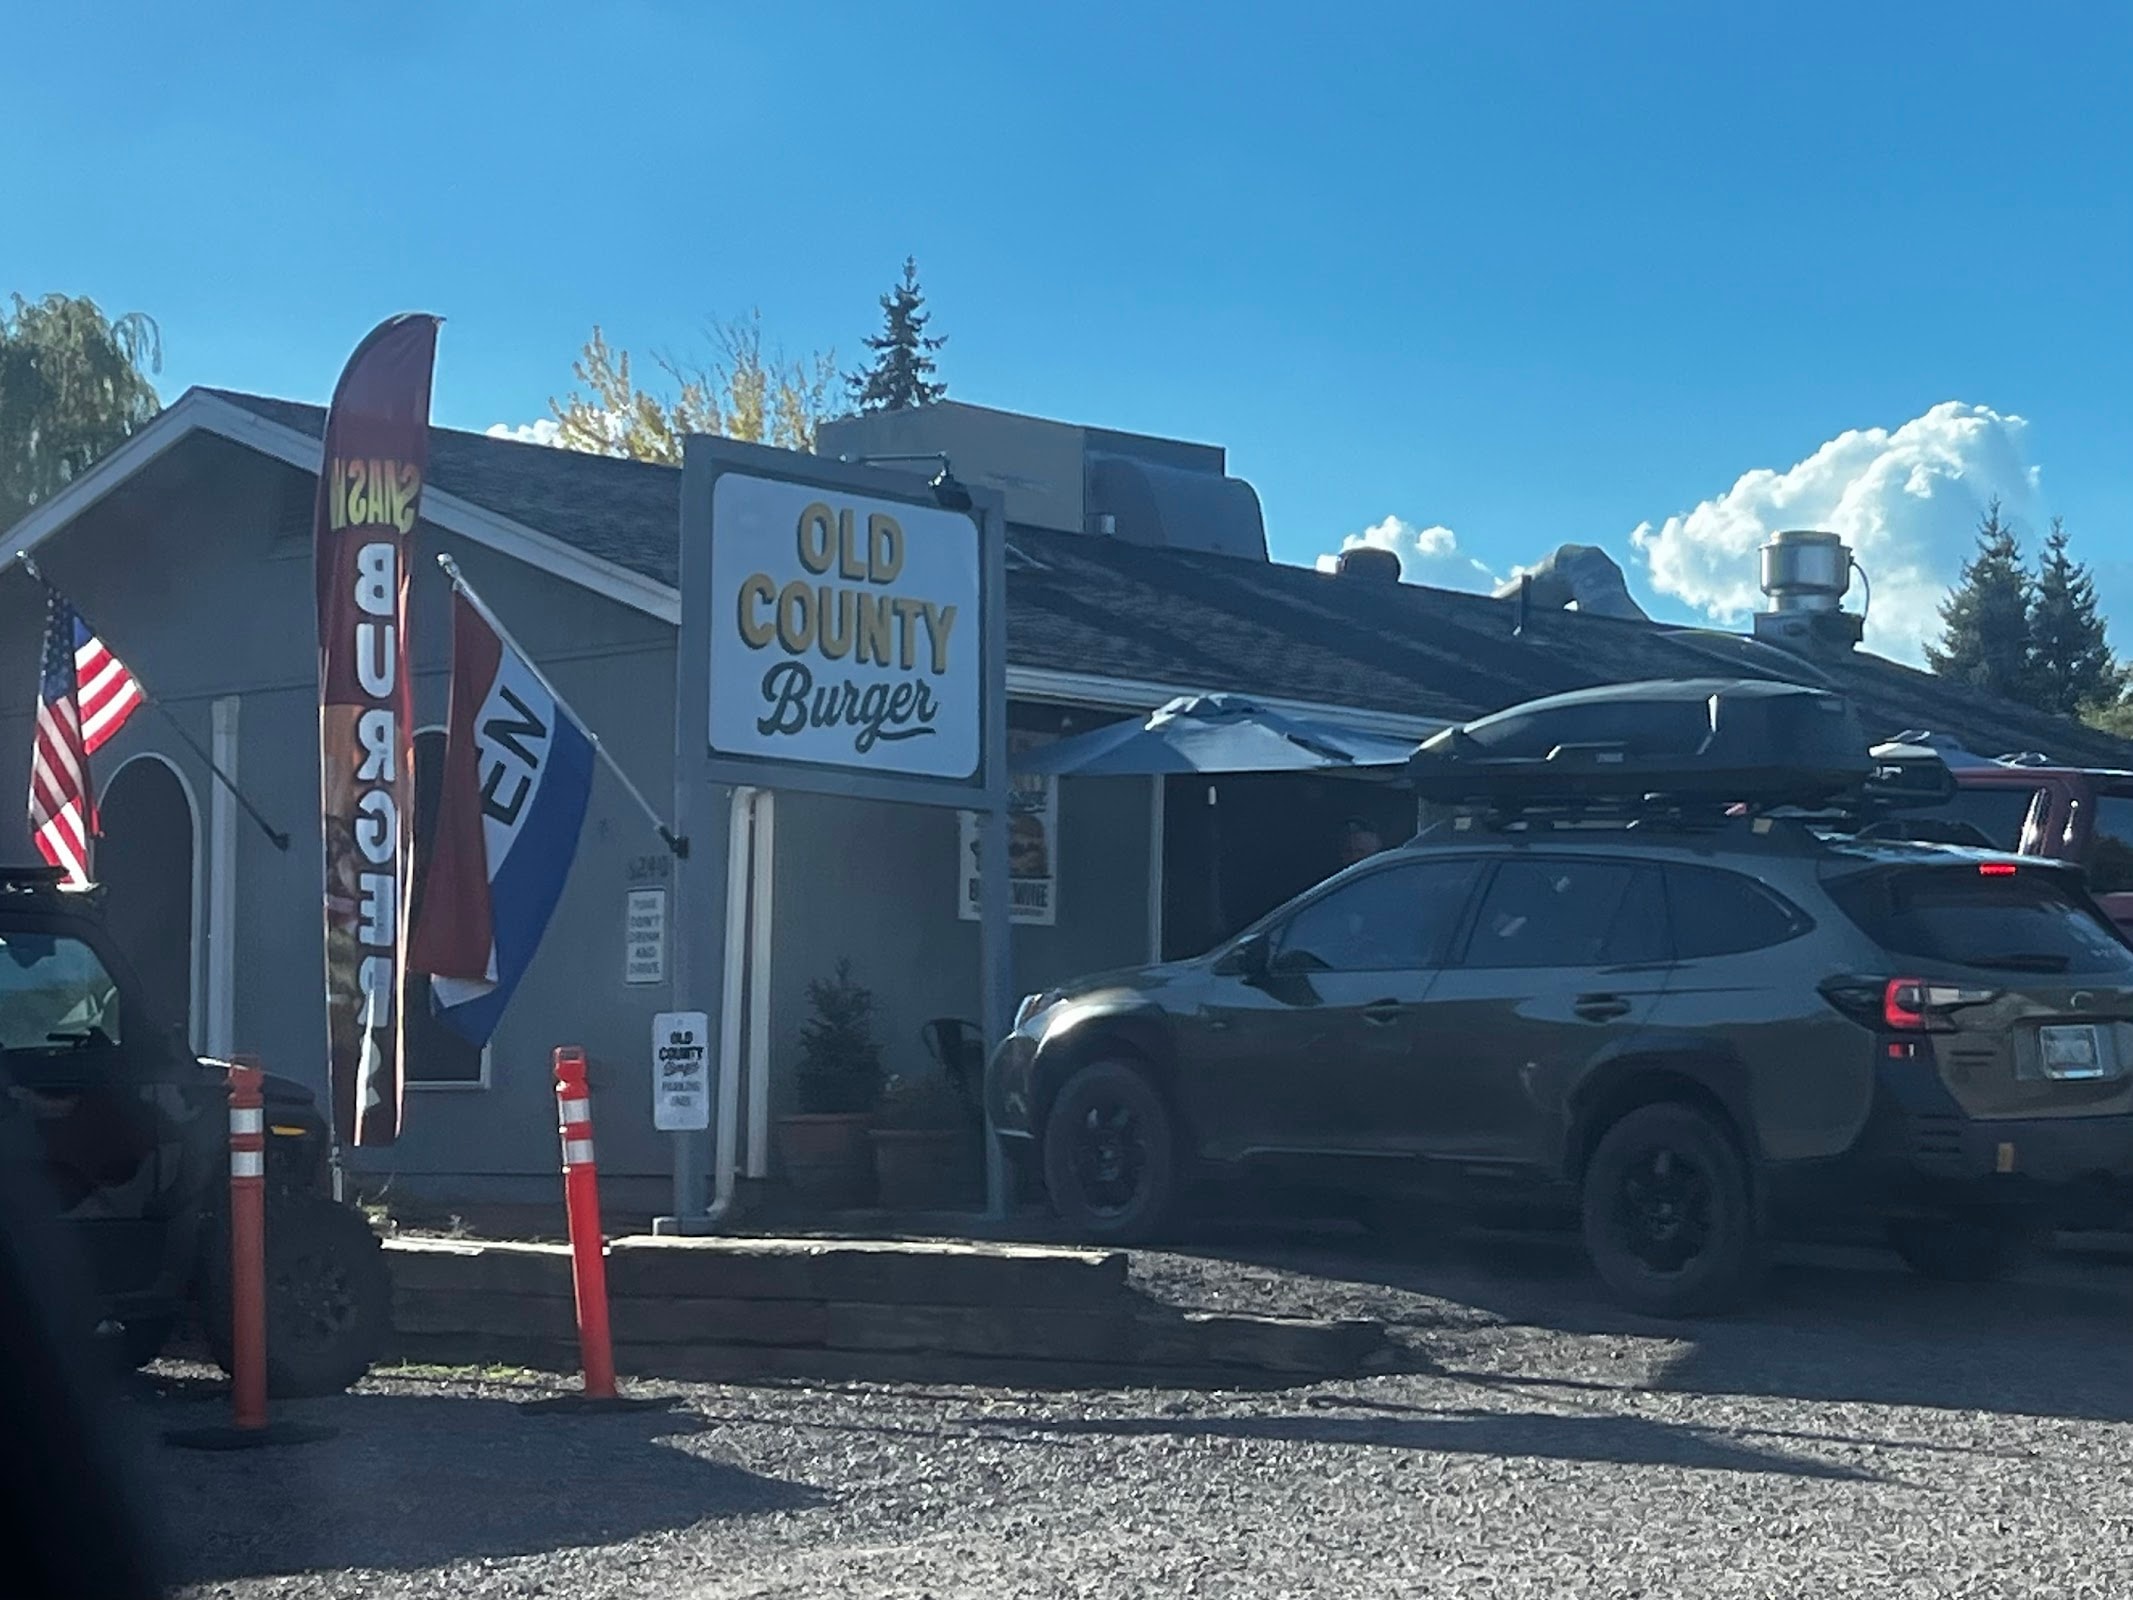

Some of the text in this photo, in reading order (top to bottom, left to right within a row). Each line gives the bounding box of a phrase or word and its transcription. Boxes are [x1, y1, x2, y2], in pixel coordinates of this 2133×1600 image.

[797, 501, 905, 584] OLD
[737, 573, 957, 675] COUNTY
[757, 660, 939, 754] Burger
[476, 686, 547, 827] EN
[670, 1031, 693, 1045] OLD
